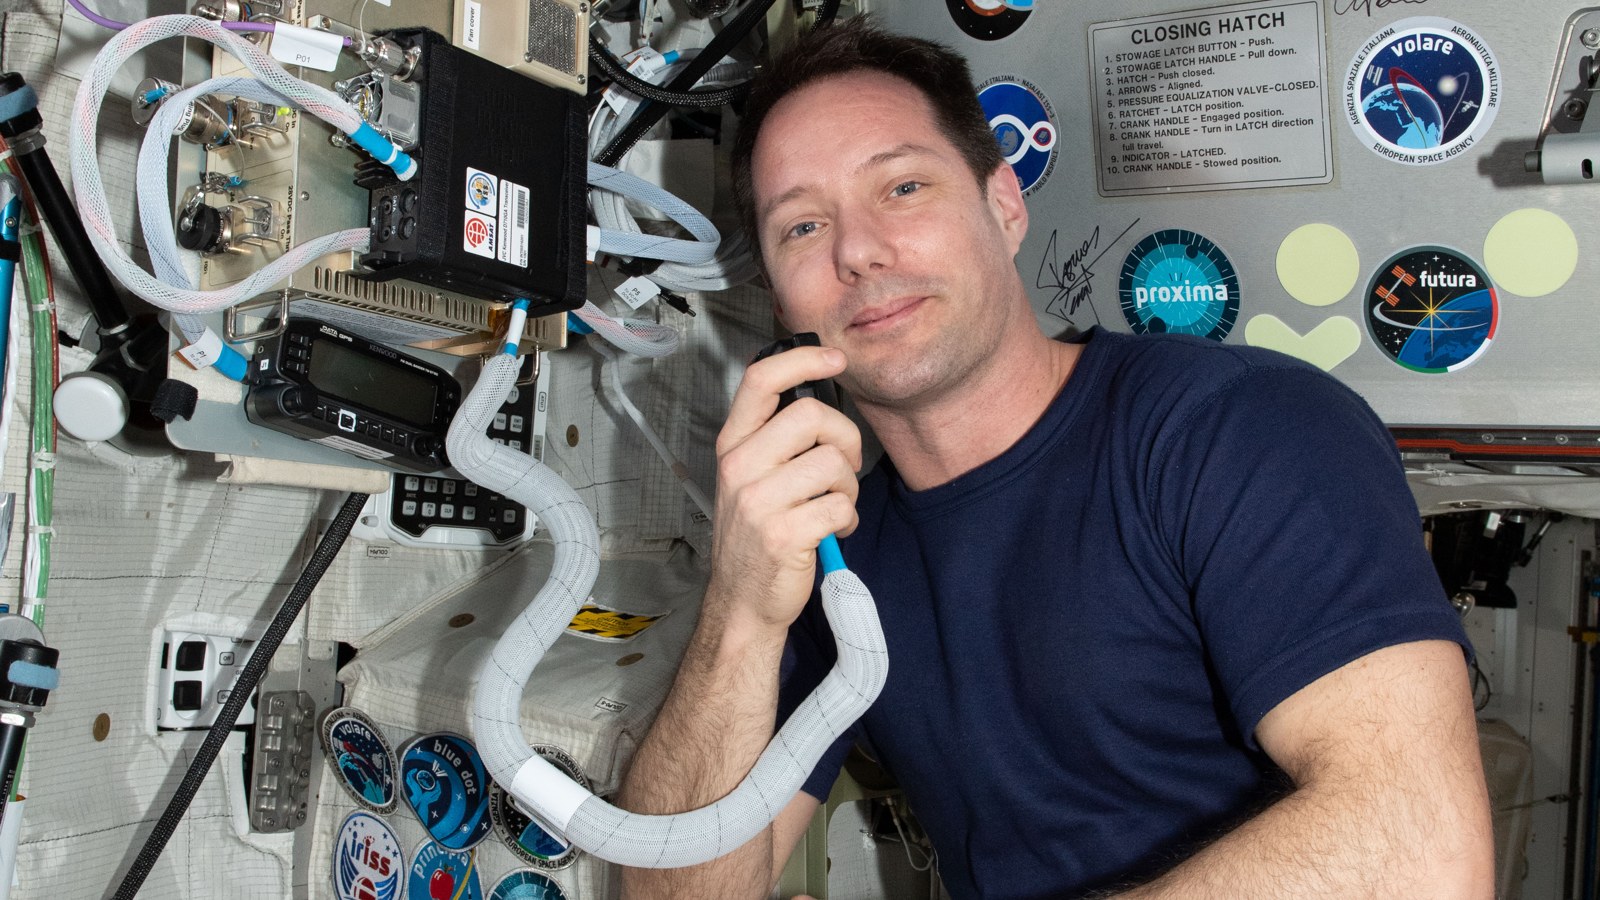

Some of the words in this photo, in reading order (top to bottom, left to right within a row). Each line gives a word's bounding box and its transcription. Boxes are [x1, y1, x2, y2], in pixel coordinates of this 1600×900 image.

[1131, 21, 1211, 44] CLOSING
[1219, 12, 1284, 34] HATCH
[1105, 55, 1112, 63] 1.
[1116, 50, 1160, 62] STOWAGE
[1164, 46, 1195, 57] LATCH
[1198, 40, 1237, 52] BUTTON
[1249, 37, 1274, 46] Push.
[1364, 27, 1395, 55] ITALIANA
[1391, 34, 1453, 58] volare
[296, 53, 311, 64] P01
[1105, 67, 1113, 75] 2.
[1116, 62, 1161, 74] STOWAGE
[1165, 58, 1195, 68] LATCH
[1199, 53, 1236, 65] HANDLE
[1248, 50, 1264, 59] Pull
[1268, 47, 1297, 57] down.
[1451, 26, 1492, 66] AERONAUTICA
[1487, 67, 1499, 108] MILITARE
[989, 75, 1015, 84] ITALIANA
[1106, 78, 1114, 86] 3.
[1117, 74, 1147, 85] HATCH
[1158, 71, 1179, 80] Push
[1182, 67, 1215, 78] closed.
[1347, 55, 1364, 90] SPAZIALE
[1107, 89, 1114, 97] 4.
[1118, 84, 1156, 95] ARROWS
[1168, 80, 1203, 92] Aligned.
[1118, 95, 1164, 107] PRESSURE
[1167, 88, 1234, 103] EQUALIZATION
[1109, 122, 1117, 130] 7.
[1120, 118, 1150, 129] CRANK
[1153, 116, 1189, 126] HANDLE
[1201, 112, 1240, 124] Engaged
[1244, 108, 1284, 120] position.
[1119, 107, 1160, 118] RATCHET
[1171, 104, 1202, 114] LATCH
[1205, 100, 1244, 112] position.
[1348, 91, 1360, 125] AGENZIA
[177, 118, 191, 132] Plug
[1110, 133, 1117, 141] 8.
[1121, 130, 1151, 140] CRANK
[1154, 127, 1190, 138] HANDLE
[1201, 124, 1221, 134] Turn
[1225, 124, 1232, 132] in
[1236, 121, 1268, 131] LATCH
[1272, 117, 1313, 128] direction
[1122, 143, 1135, 151] full
[1137, 141, 1163, 150] travel.
[1122, 152, 1170, 162] INDICATOR
[1181, 148, 1226, 158] LATCHED.
[1373, 142, 1416, 163] EUROPEAN
[1418, 153, 1443, 163] SPACE
[1446, 135, 1475, 159] AGENCY
[1032, 175, 1047, 193] PAOLO
[1045, 151, 1058, 176] NESPOLI
[1107, 166, 1120, 175] 10.
[1123, 163, 1153, 173] CRANK
[1156, 161, 1192, 171] HANDLE
[1203, 157, 1238, 168] Stowed
[1241, 154, 1281, 166] position.
[1419, 270, 1476, 288] futura
[631, 287, 641, 296] P5
[1135, 279, 1228, 308] proxima
[339, 721, 371, 741] volare
[433, 740, 462, 768] blue
[461, 770, 477, 796] dot
[555, 752, 588, 788] AERONAUTI
[491, 792, 503, 827] AGENZIA
[350, 831, 391, 877] iriss
[504, 836, 536, 865] EUROPEAN
[538, 860, 557, 869] SPACE
[557, 848, 577, 868] AGENCY
